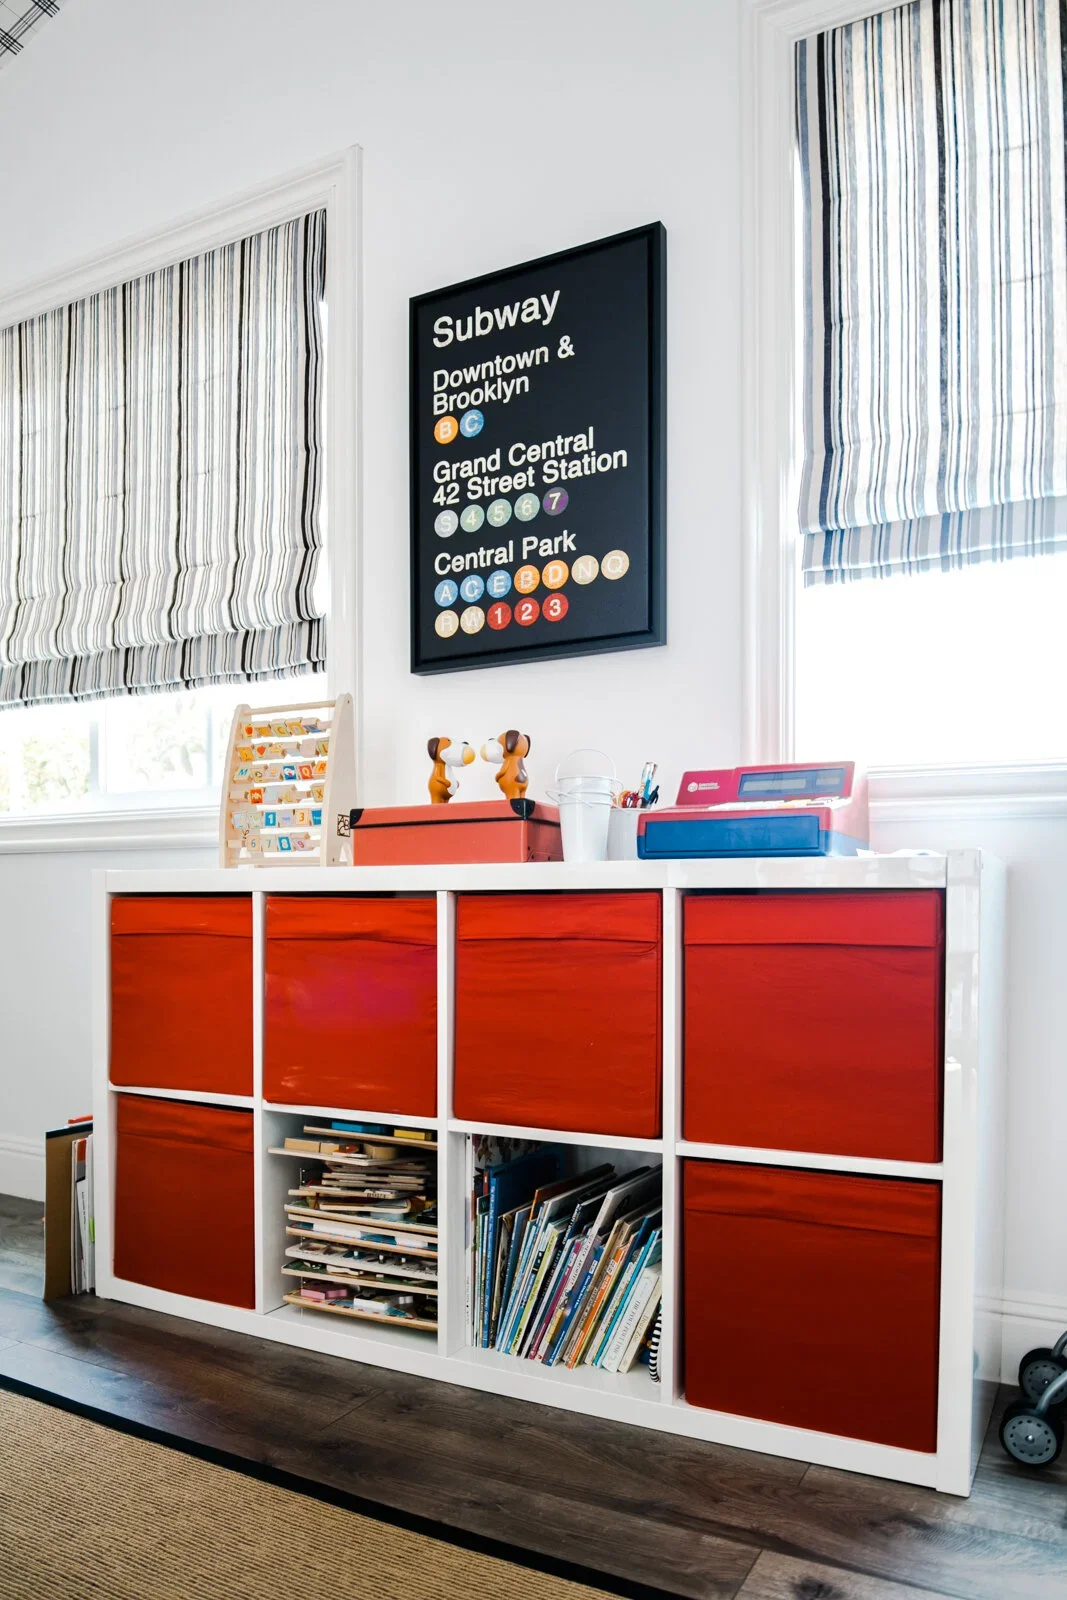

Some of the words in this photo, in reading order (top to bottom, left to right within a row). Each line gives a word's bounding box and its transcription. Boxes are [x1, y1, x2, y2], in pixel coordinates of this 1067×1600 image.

[433, 290, 560, 347] Subway
[434, 347, 548, 392] Downtown
[558, 336, 575, 358] &
[434, 376, 529, 415] Brooklyn
[433, 448, 500, 483] Grand
[509, 426, 593, 466] Central
[433, 483, 459, 506] 42
[467, 466, 535, 499] Street
[543, 450, 627, 483] Station
[435, 540, 513, 575] Central
[523, 530, 576, 559] Park
[299, 812, 304, 822] 3
[251, 838, 256, 848] 6
[297, 840, 304, 848] 9
